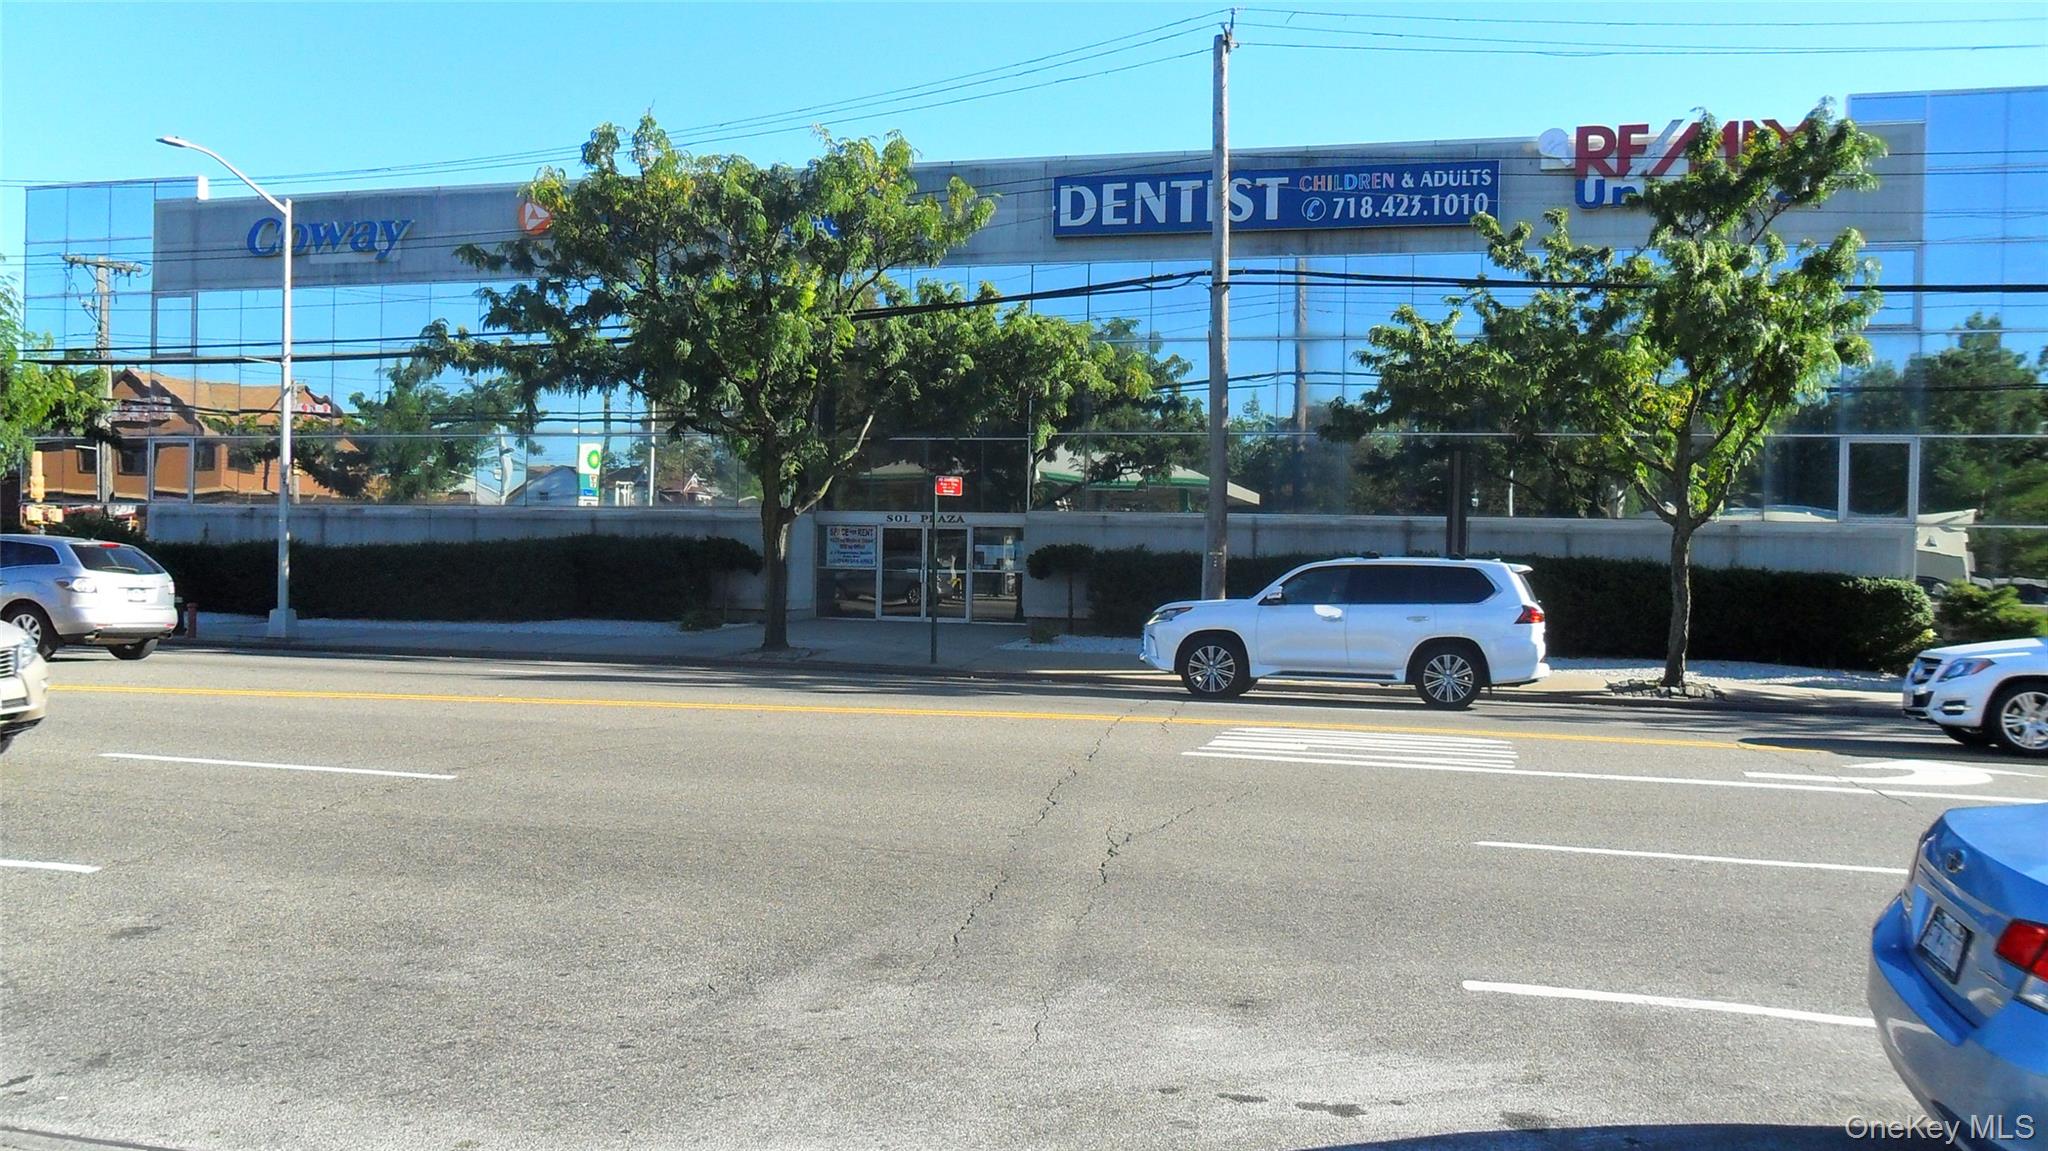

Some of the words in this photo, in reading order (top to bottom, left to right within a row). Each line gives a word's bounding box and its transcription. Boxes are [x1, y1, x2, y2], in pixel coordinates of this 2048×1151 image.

[1300, 173, 1395, 192] CHILDREN
[1401, 171, 1414, 188] &
[1420, 169, 1491, 187] ADULTS
[1059, 177, 1289, 227] DENTIST
[1332, 193, 1489, 219] 718.423.1010
[247, 217, 412, 260] Coway
[886, 514, 911, 523] SOL
